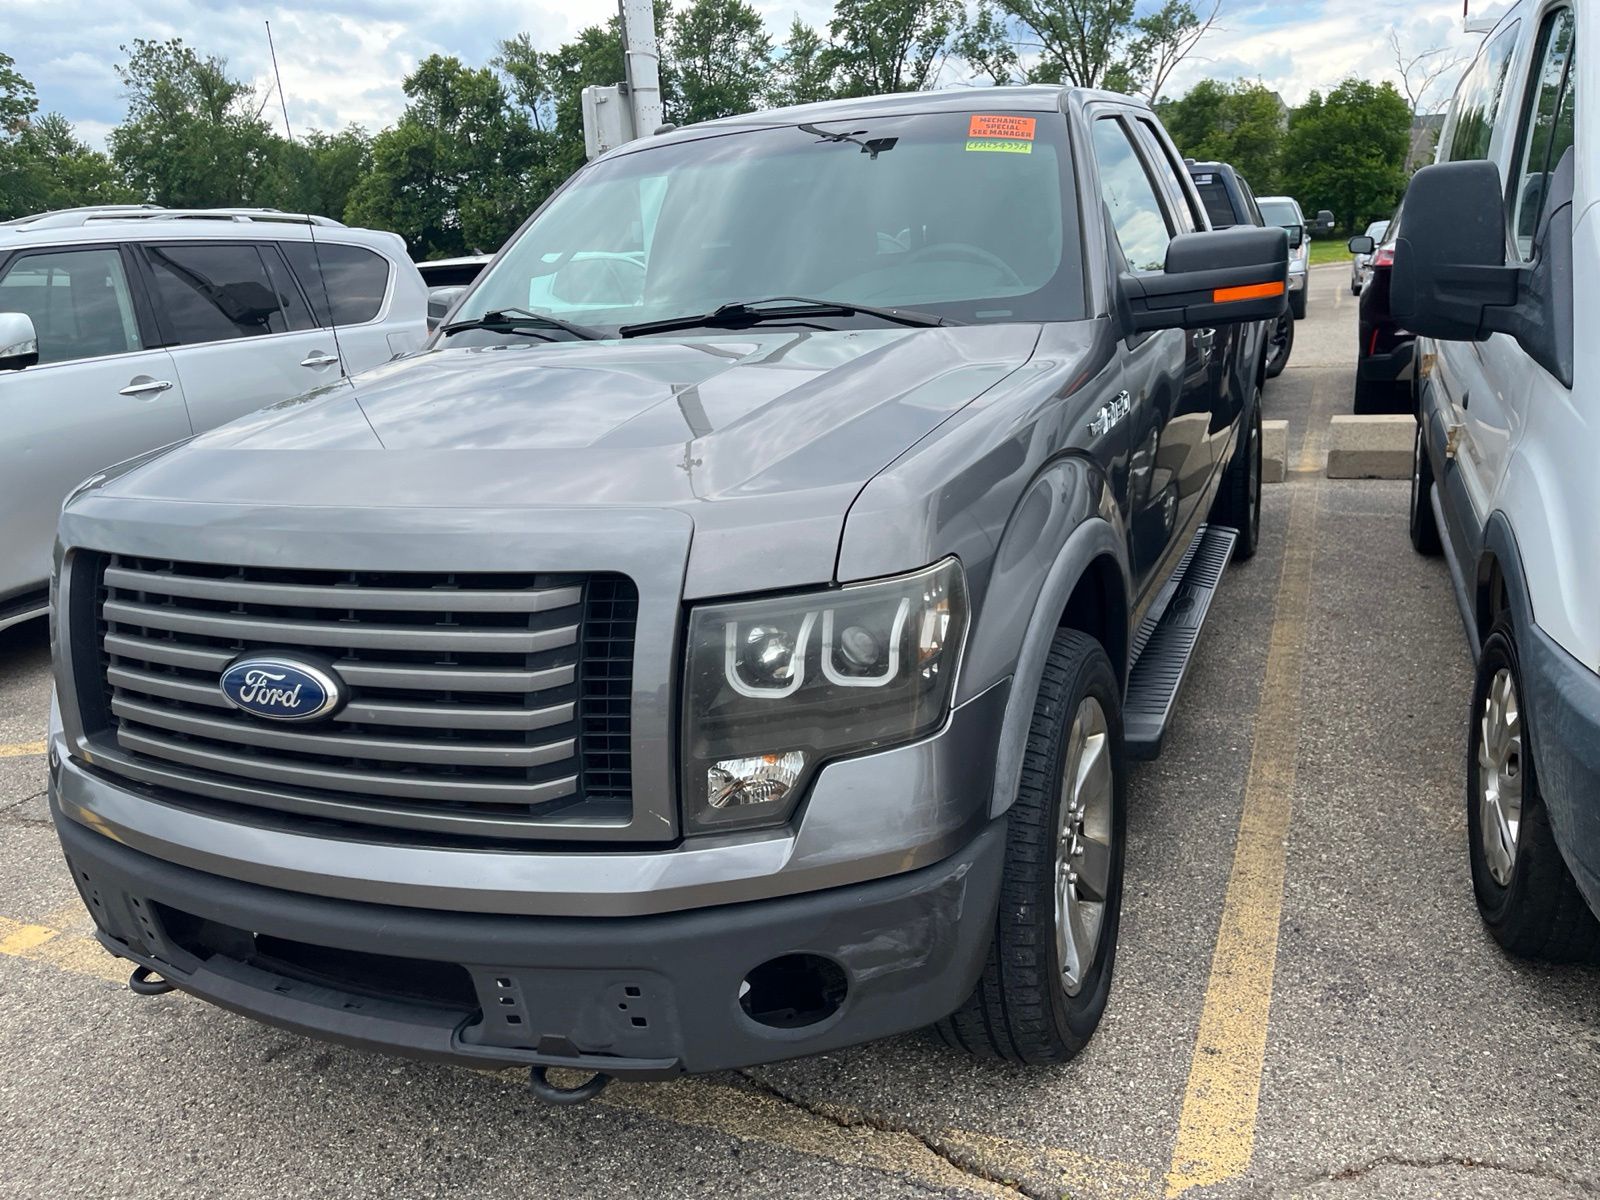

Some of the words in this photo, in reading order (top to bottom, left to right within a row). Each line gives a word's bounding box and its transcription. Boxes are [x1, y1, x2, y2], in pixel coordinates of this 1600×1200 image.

[979, 117, 1028, 125] MECHANICS
[989, 129, 1032, 137] MANAGER
[240, 669, 302, 708] Ford
